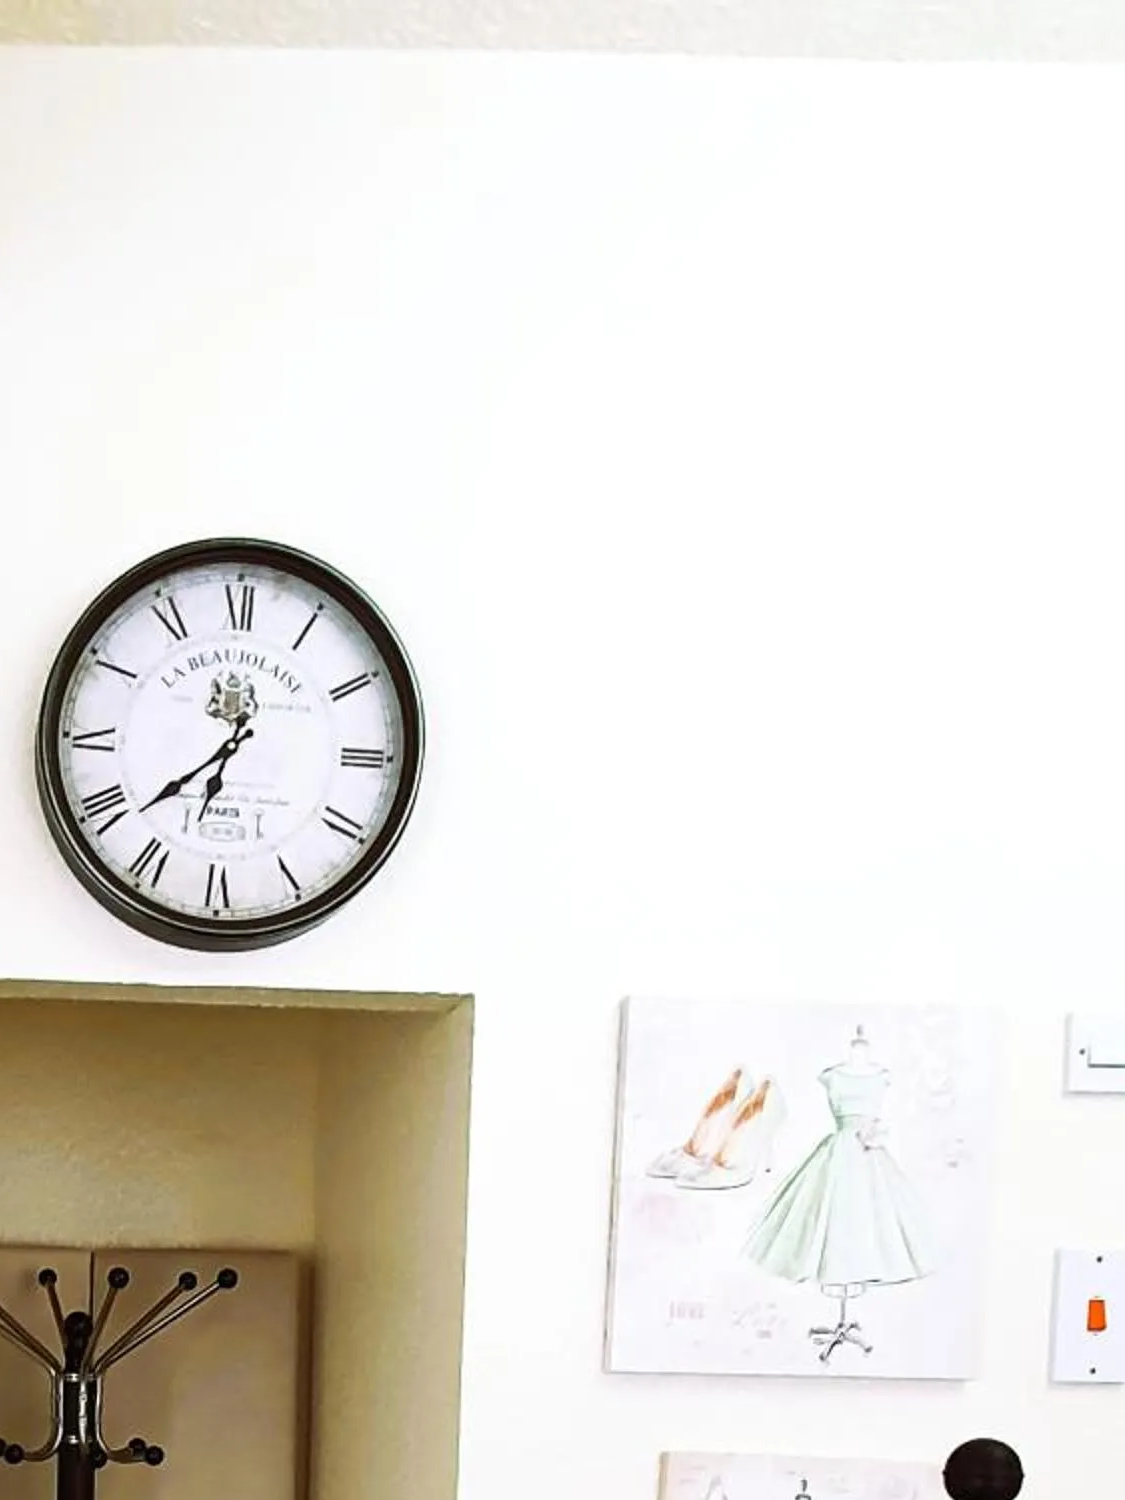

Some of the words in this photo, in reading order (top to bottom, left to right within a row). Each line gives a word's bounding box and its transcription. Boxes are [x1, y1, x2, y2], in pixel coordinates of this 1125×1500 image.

[160, 666, 187, 689] LA
[187, 648, 303, 694] BEAUJOLAISE
[340, 747, 385, 768] III
